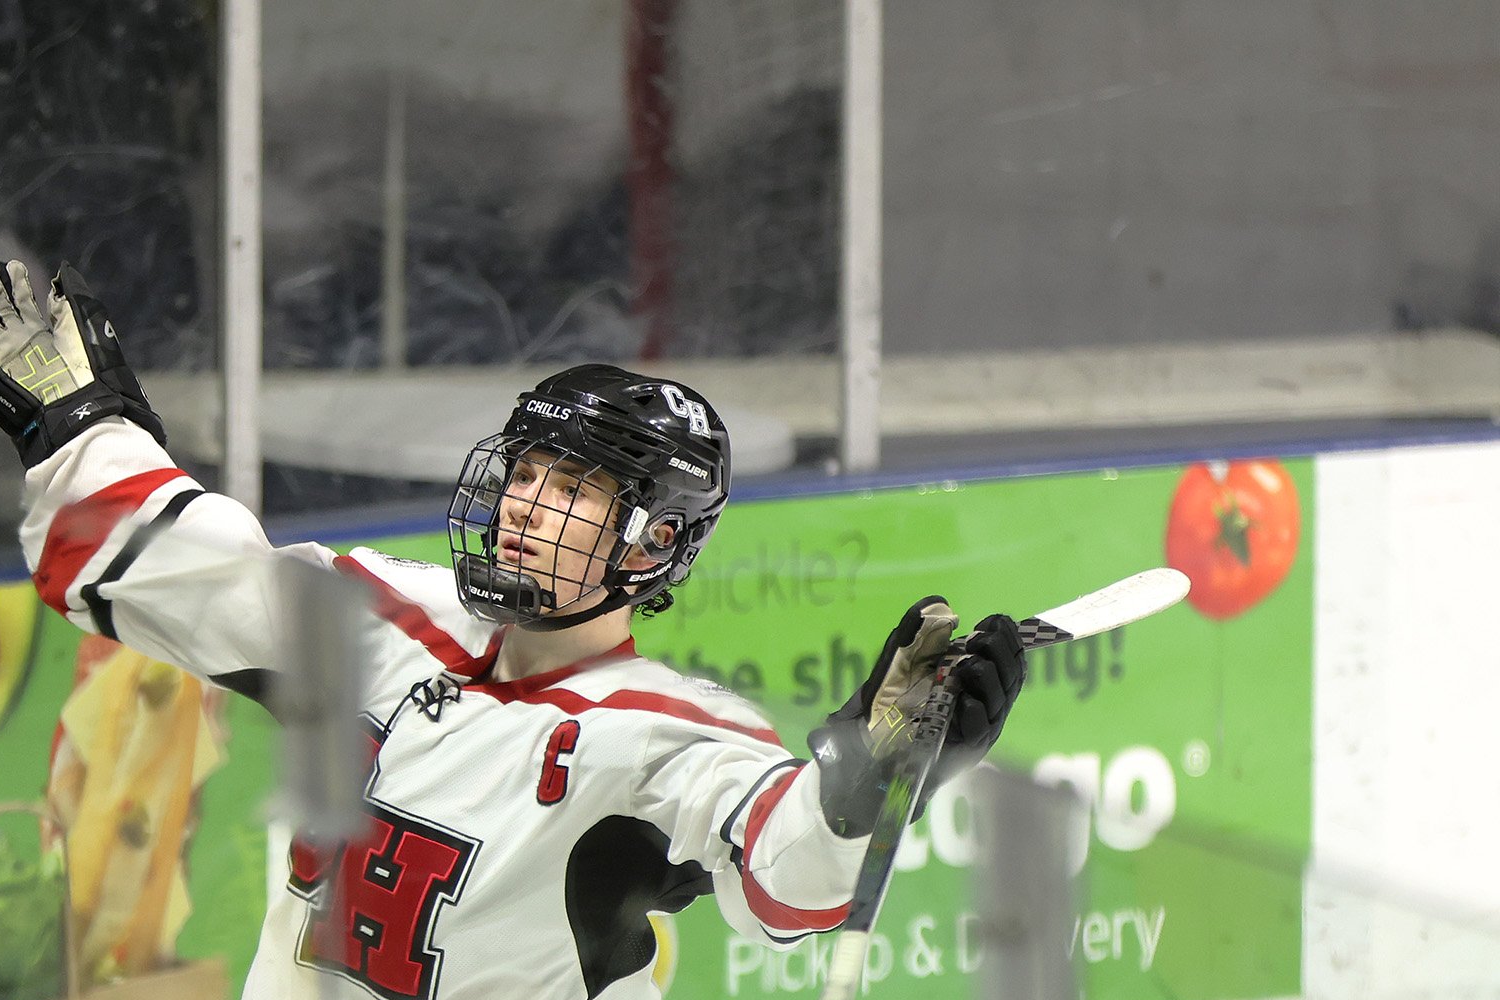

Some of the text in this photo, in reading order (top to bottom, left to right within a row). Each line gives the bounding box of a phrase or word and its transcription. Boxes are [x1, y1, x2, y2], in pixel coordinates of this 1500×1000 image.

[526, 399, 572, 421] CHILLS
[660, 384, 711, 439] CH
[668, 456, 709, 481] BAUER
[628, 561, 673, 583] BAUER
[677, 530, 868, 630] pickle?
[464, 584, 504, 602] AUER
[537, 719, 581, 807] C
[726, 926, 894, 996] Pickp
[904, 913, 944, 978] &
